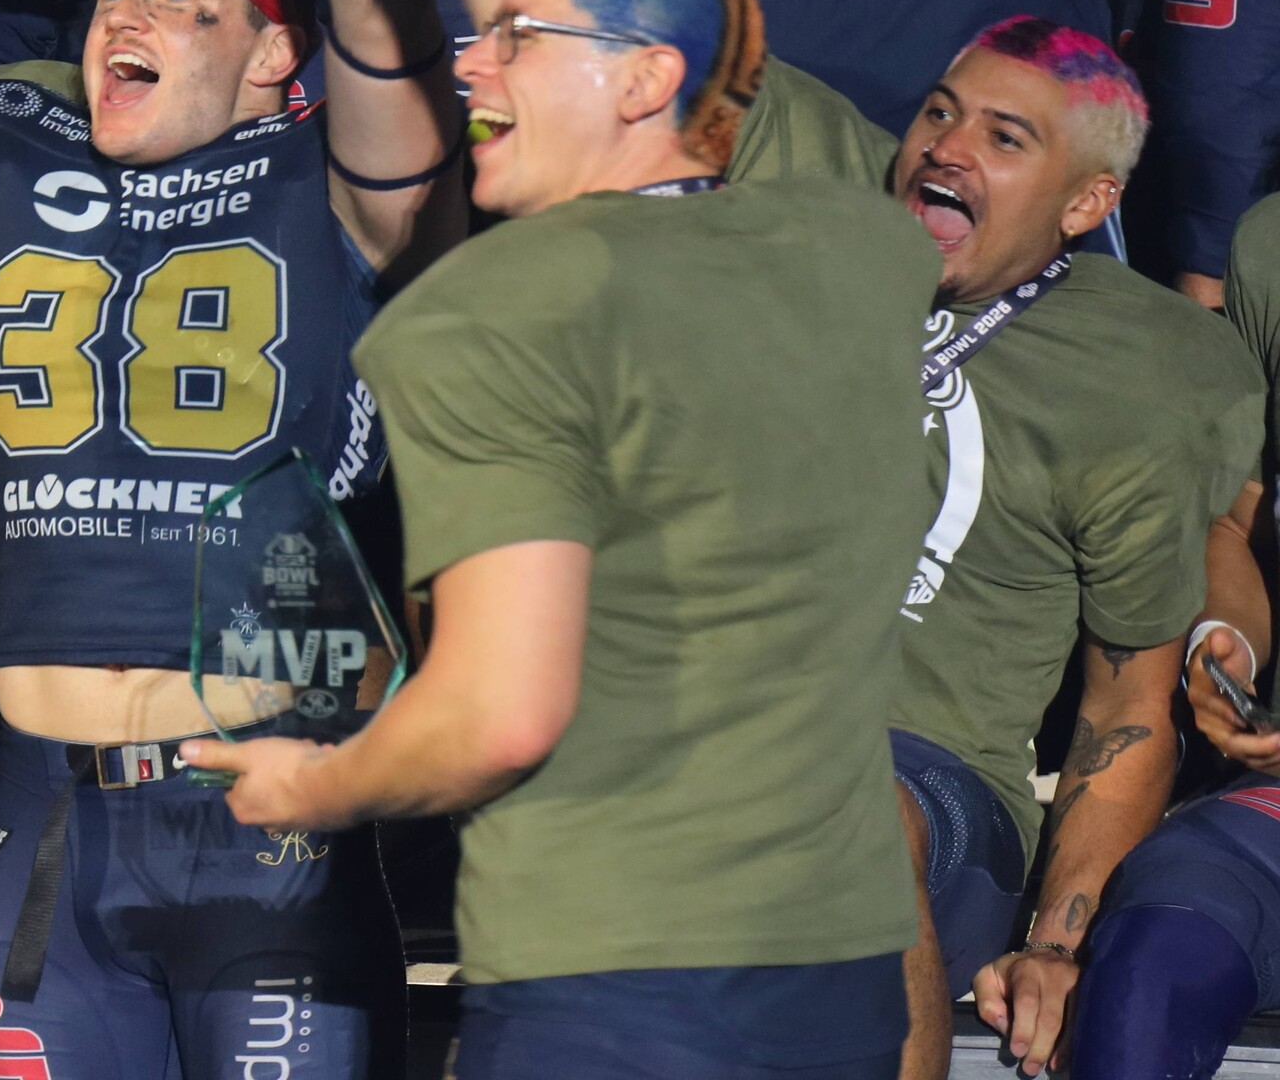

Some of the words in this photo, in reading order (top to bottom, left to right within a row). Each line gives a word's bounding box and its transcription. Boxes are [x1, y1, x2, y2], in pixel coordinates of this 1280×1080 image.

[120, 156, 270, 201] Sachsen
[934, 333, 978, 367] BOWL
[973, 300, 1013, 336] 2026
[4, 515, 133, 540] AUTOMOBILE
[149, 526, 183, 542] SEIT
[263, 567, 320, 586] BOWL
[220, 629, 367, 688] MVP
